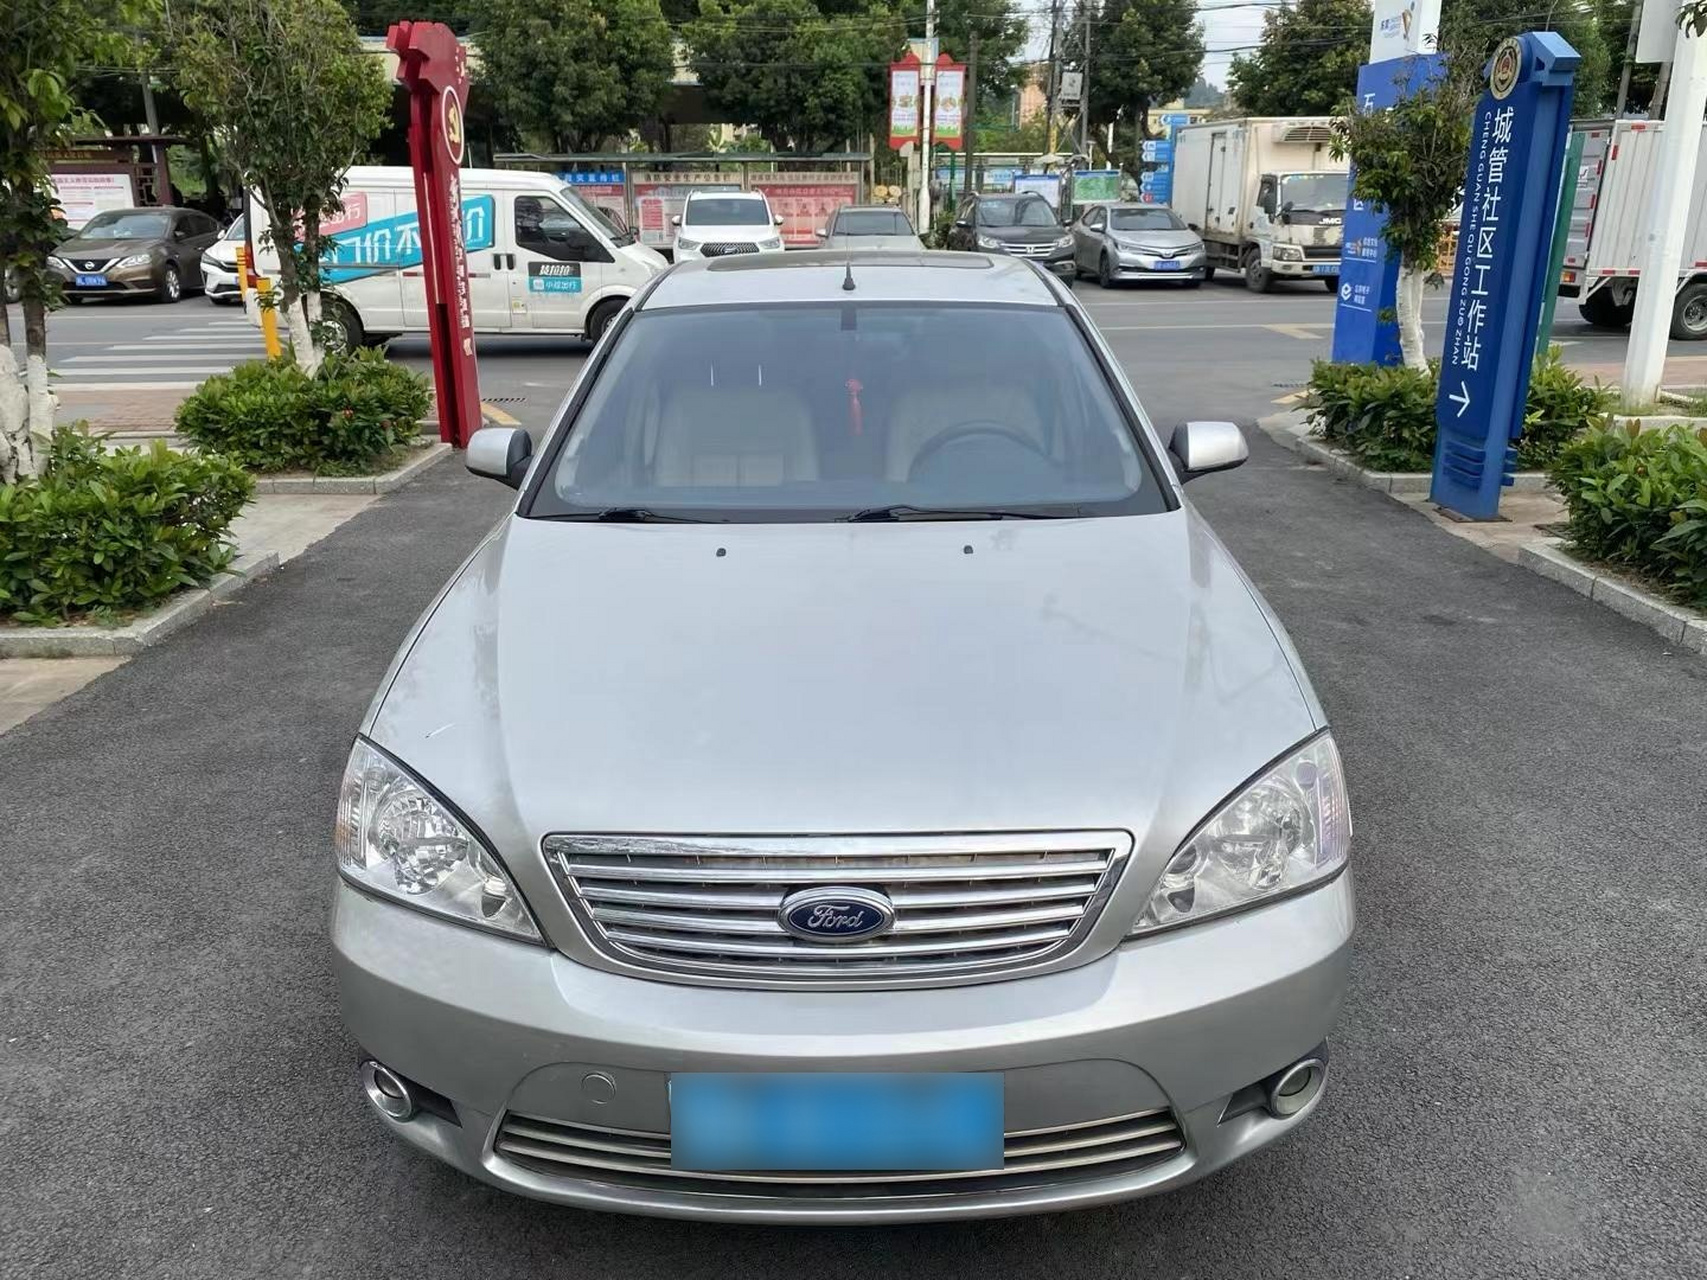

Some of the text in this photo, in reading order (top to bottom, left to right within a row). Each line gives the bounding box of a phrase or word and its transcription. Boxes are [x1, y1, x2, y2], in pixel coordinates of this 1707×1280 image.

[1318, 217, 1342, 225] JMC
[1452, 111, 1491, 364] CHENG GUAN SHE QU GONG ZUO ZHAN
[1461, 106, 1514, 371] 城管社区工作站
[807, 904, 865, 929] Ford
